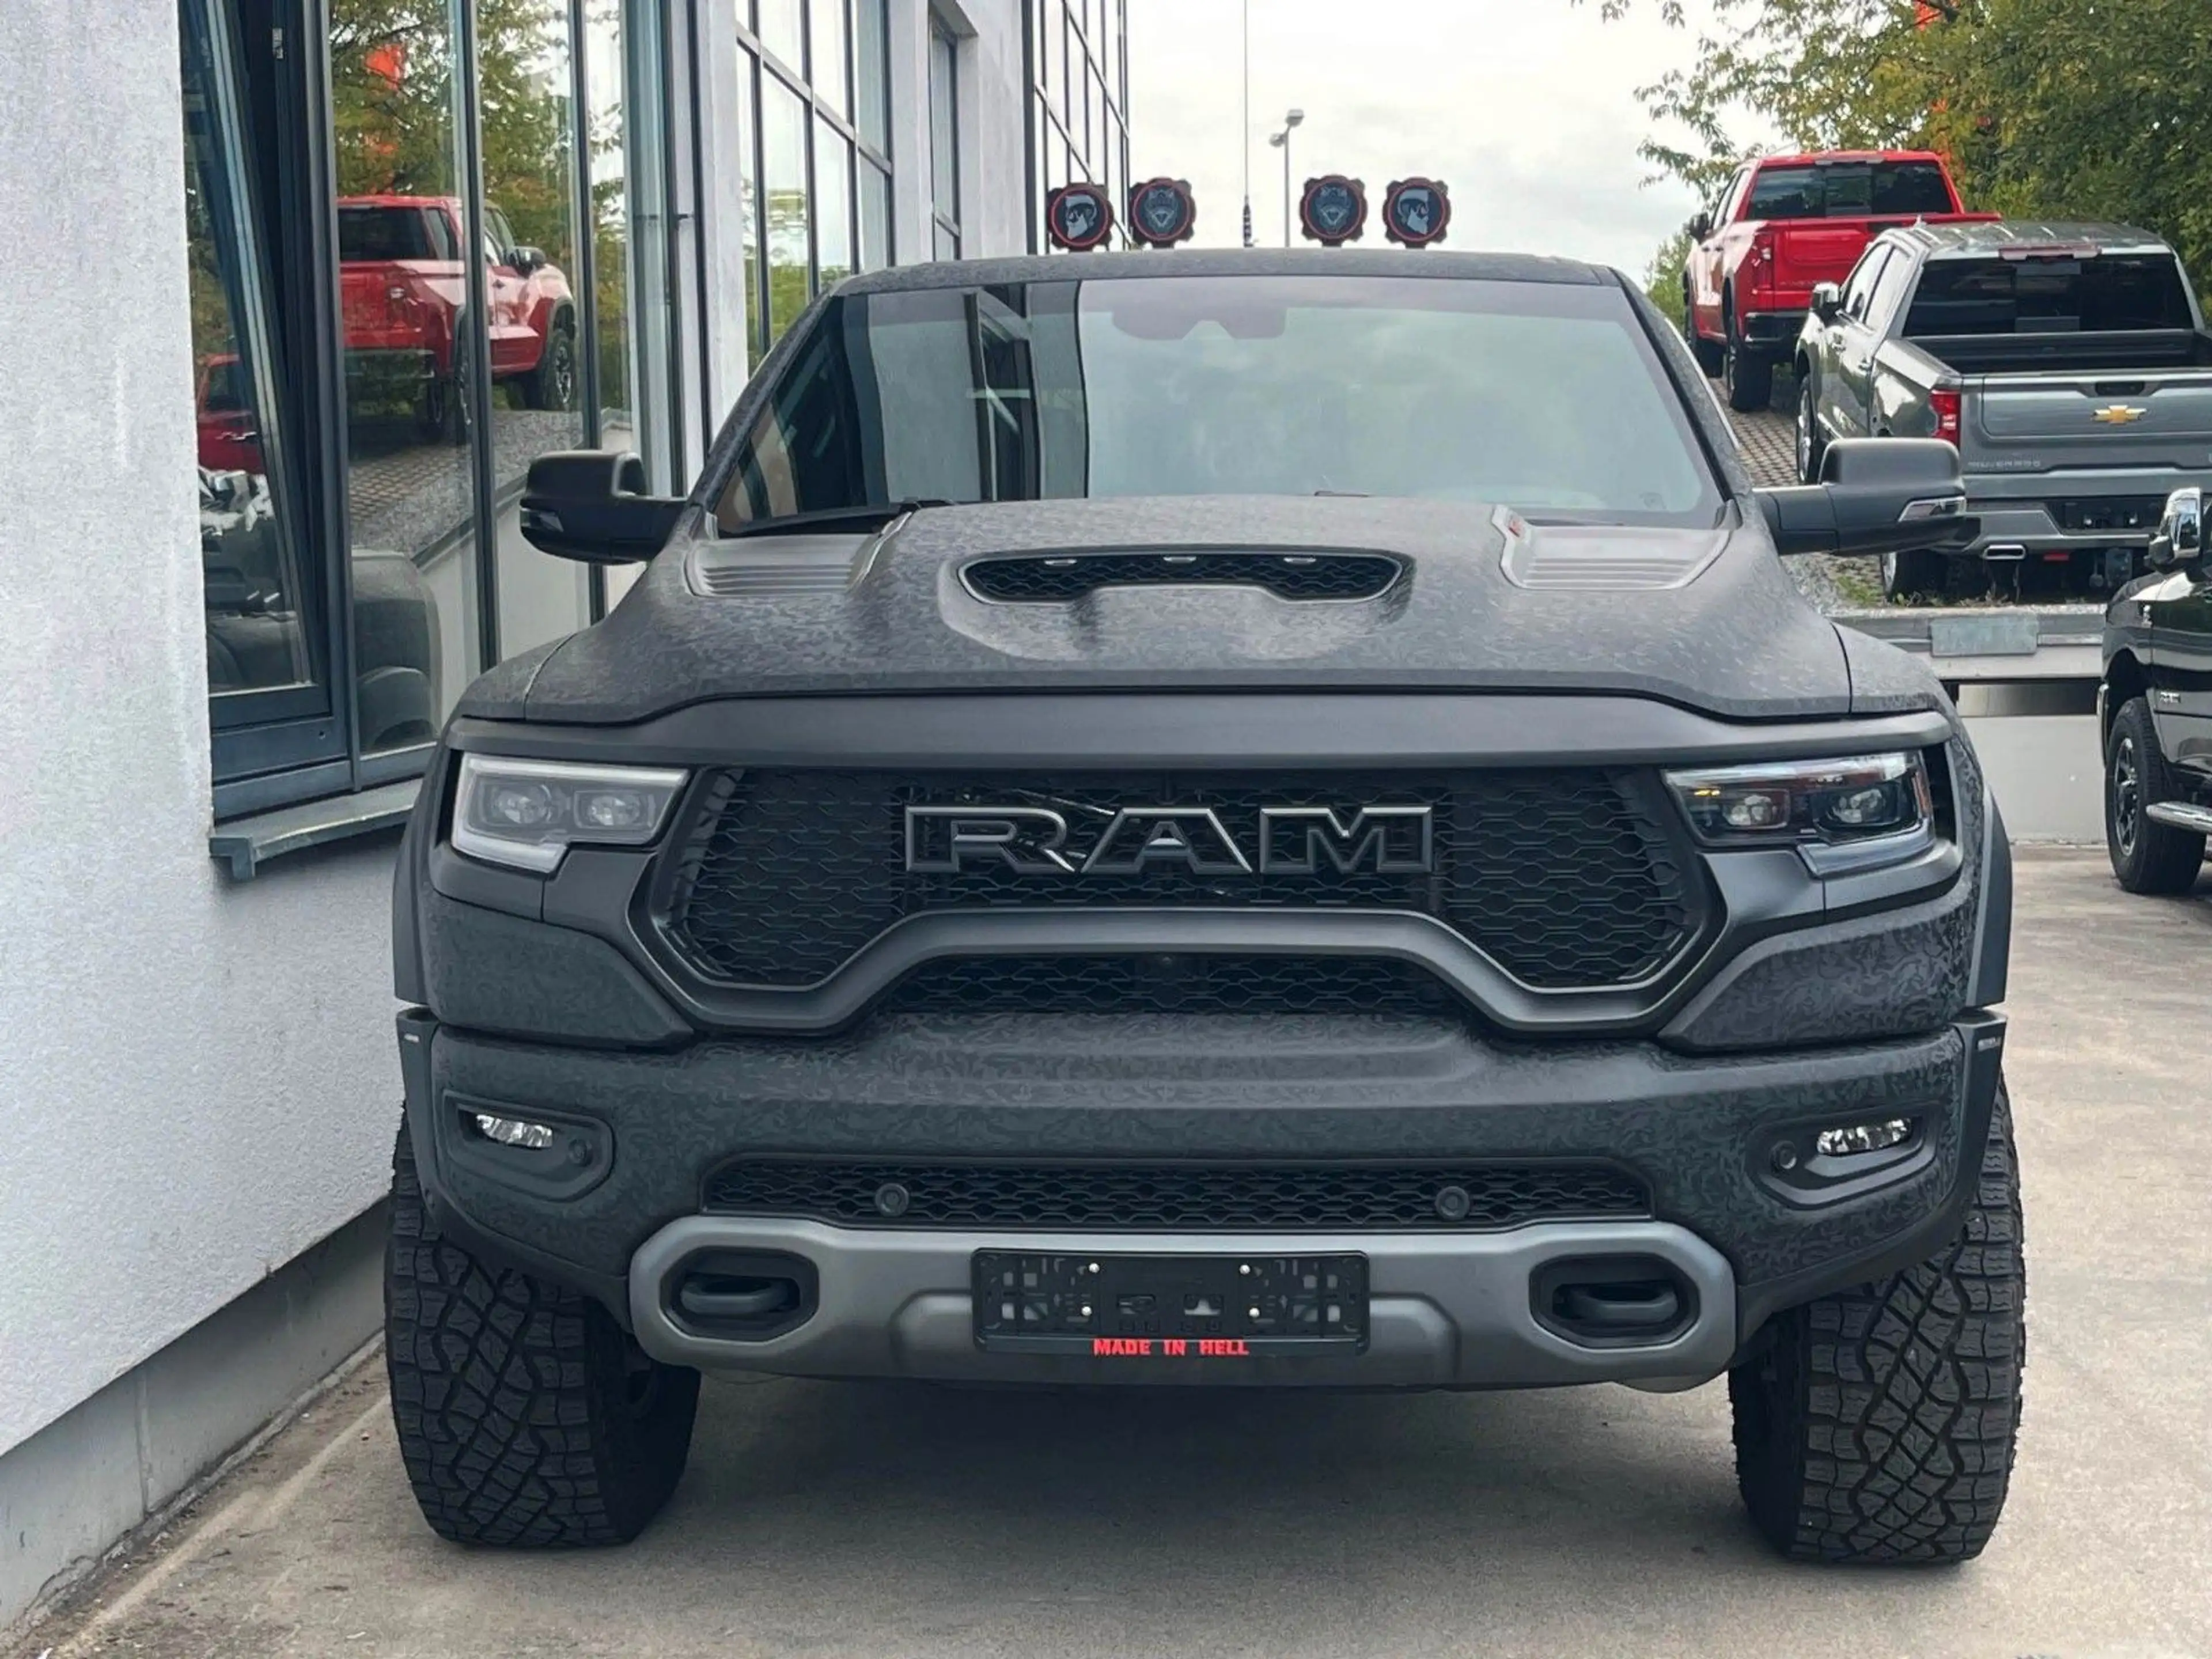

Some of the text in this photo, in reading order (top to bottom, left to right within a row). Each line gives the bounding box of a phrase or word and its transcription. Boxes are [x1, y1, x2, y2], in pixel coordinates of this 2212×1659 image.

[906, 806, 1432, 873] RAM
[1093, 1339, 1249, 1355] MADE IN HELL
